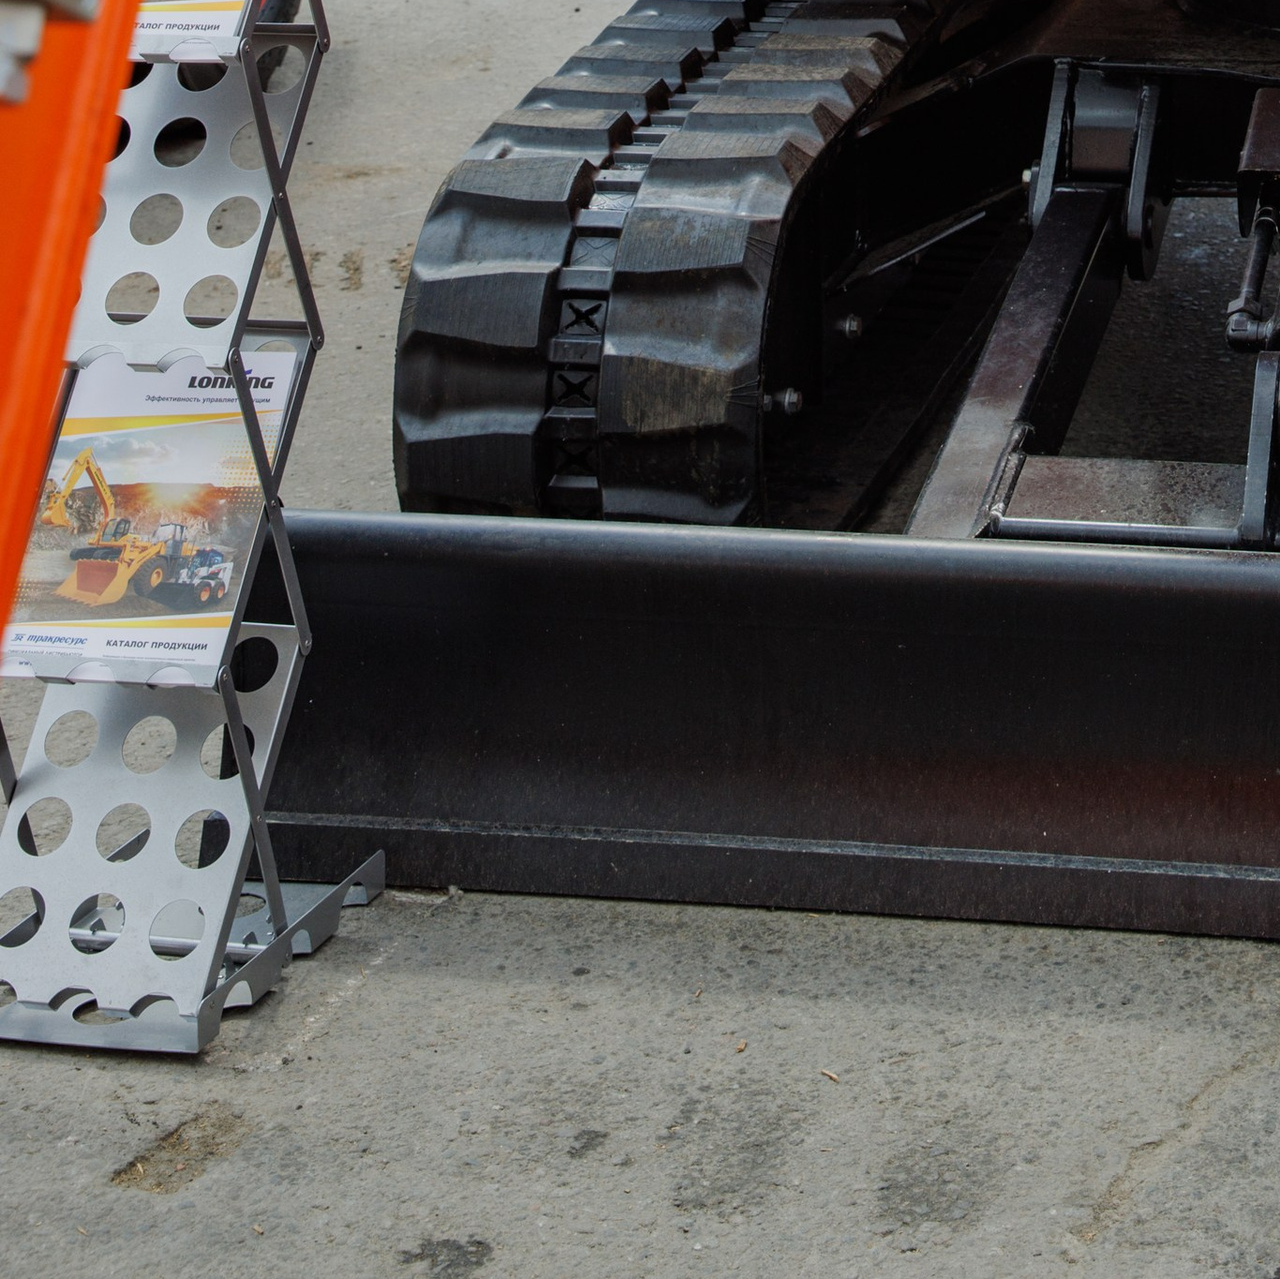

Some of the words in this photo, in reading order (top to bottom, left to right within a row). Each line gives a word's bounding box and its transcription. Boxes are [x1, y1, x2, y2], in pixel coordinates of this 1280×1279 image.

[165, 23, 220, 31] ПРОДУКЦИИ
[145, 395, 201, 403] Эффективность
[202, 396, 238, 404] управляет
[26, 634, 88, 646] тракресурс
[106, 639, 149, 649] КАТАЛОГ
[151, 641, 208, 651] ПРОДУКЦИИ
